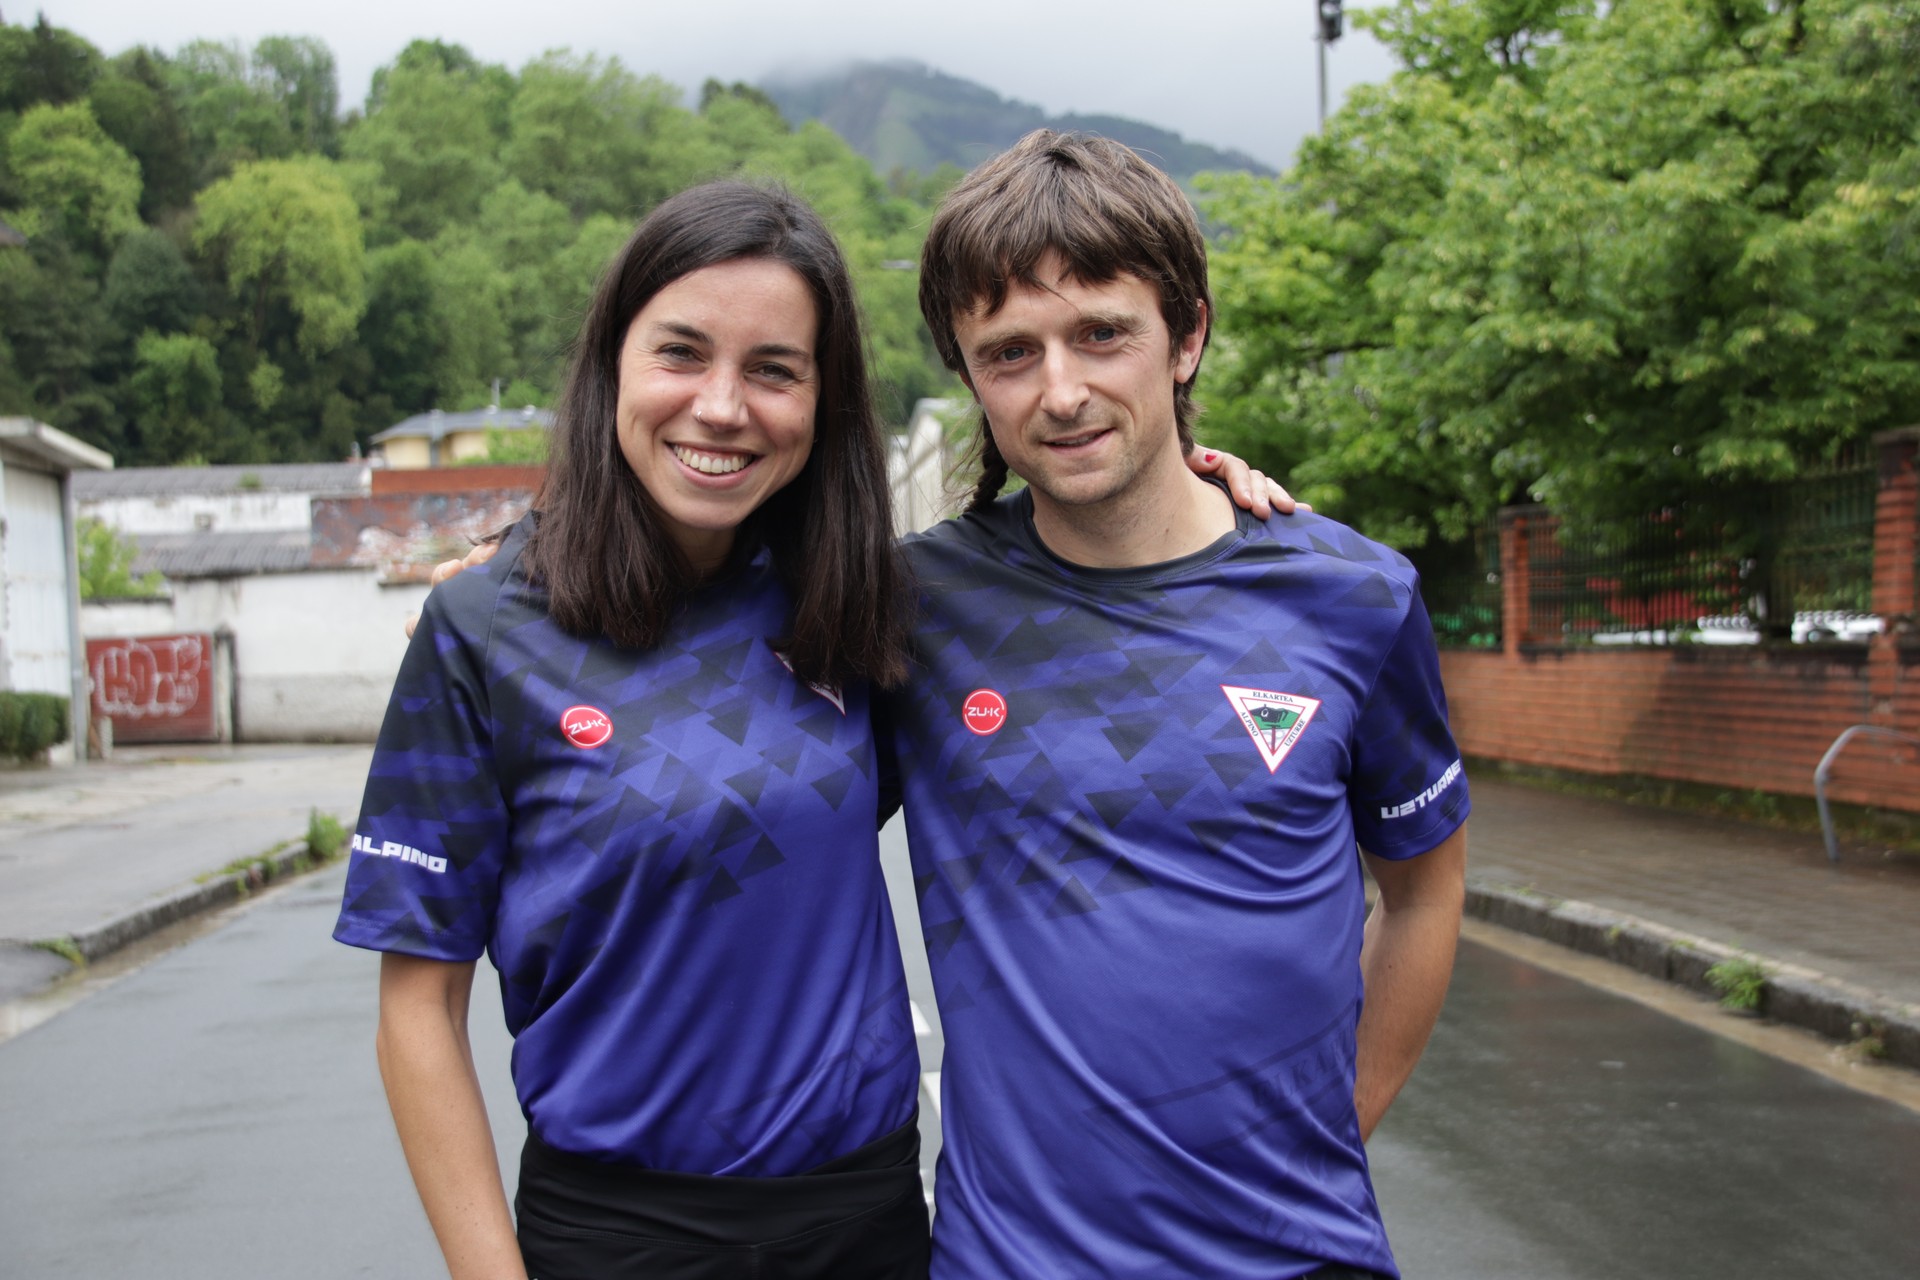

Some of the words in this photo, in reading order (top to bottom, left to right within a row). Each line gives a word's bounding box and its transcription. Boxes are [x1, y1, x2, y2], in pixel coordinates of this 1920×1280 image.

[1253, 691, 1293, 703] ELKARTEA
[1240, 711, 1259, 737] ALPINO
[1284, 718, 1306, 747] UZTURRE
[1381, 758, 1461, 819] UZTURRE
[352, 833, 447, 873] ALPINO
